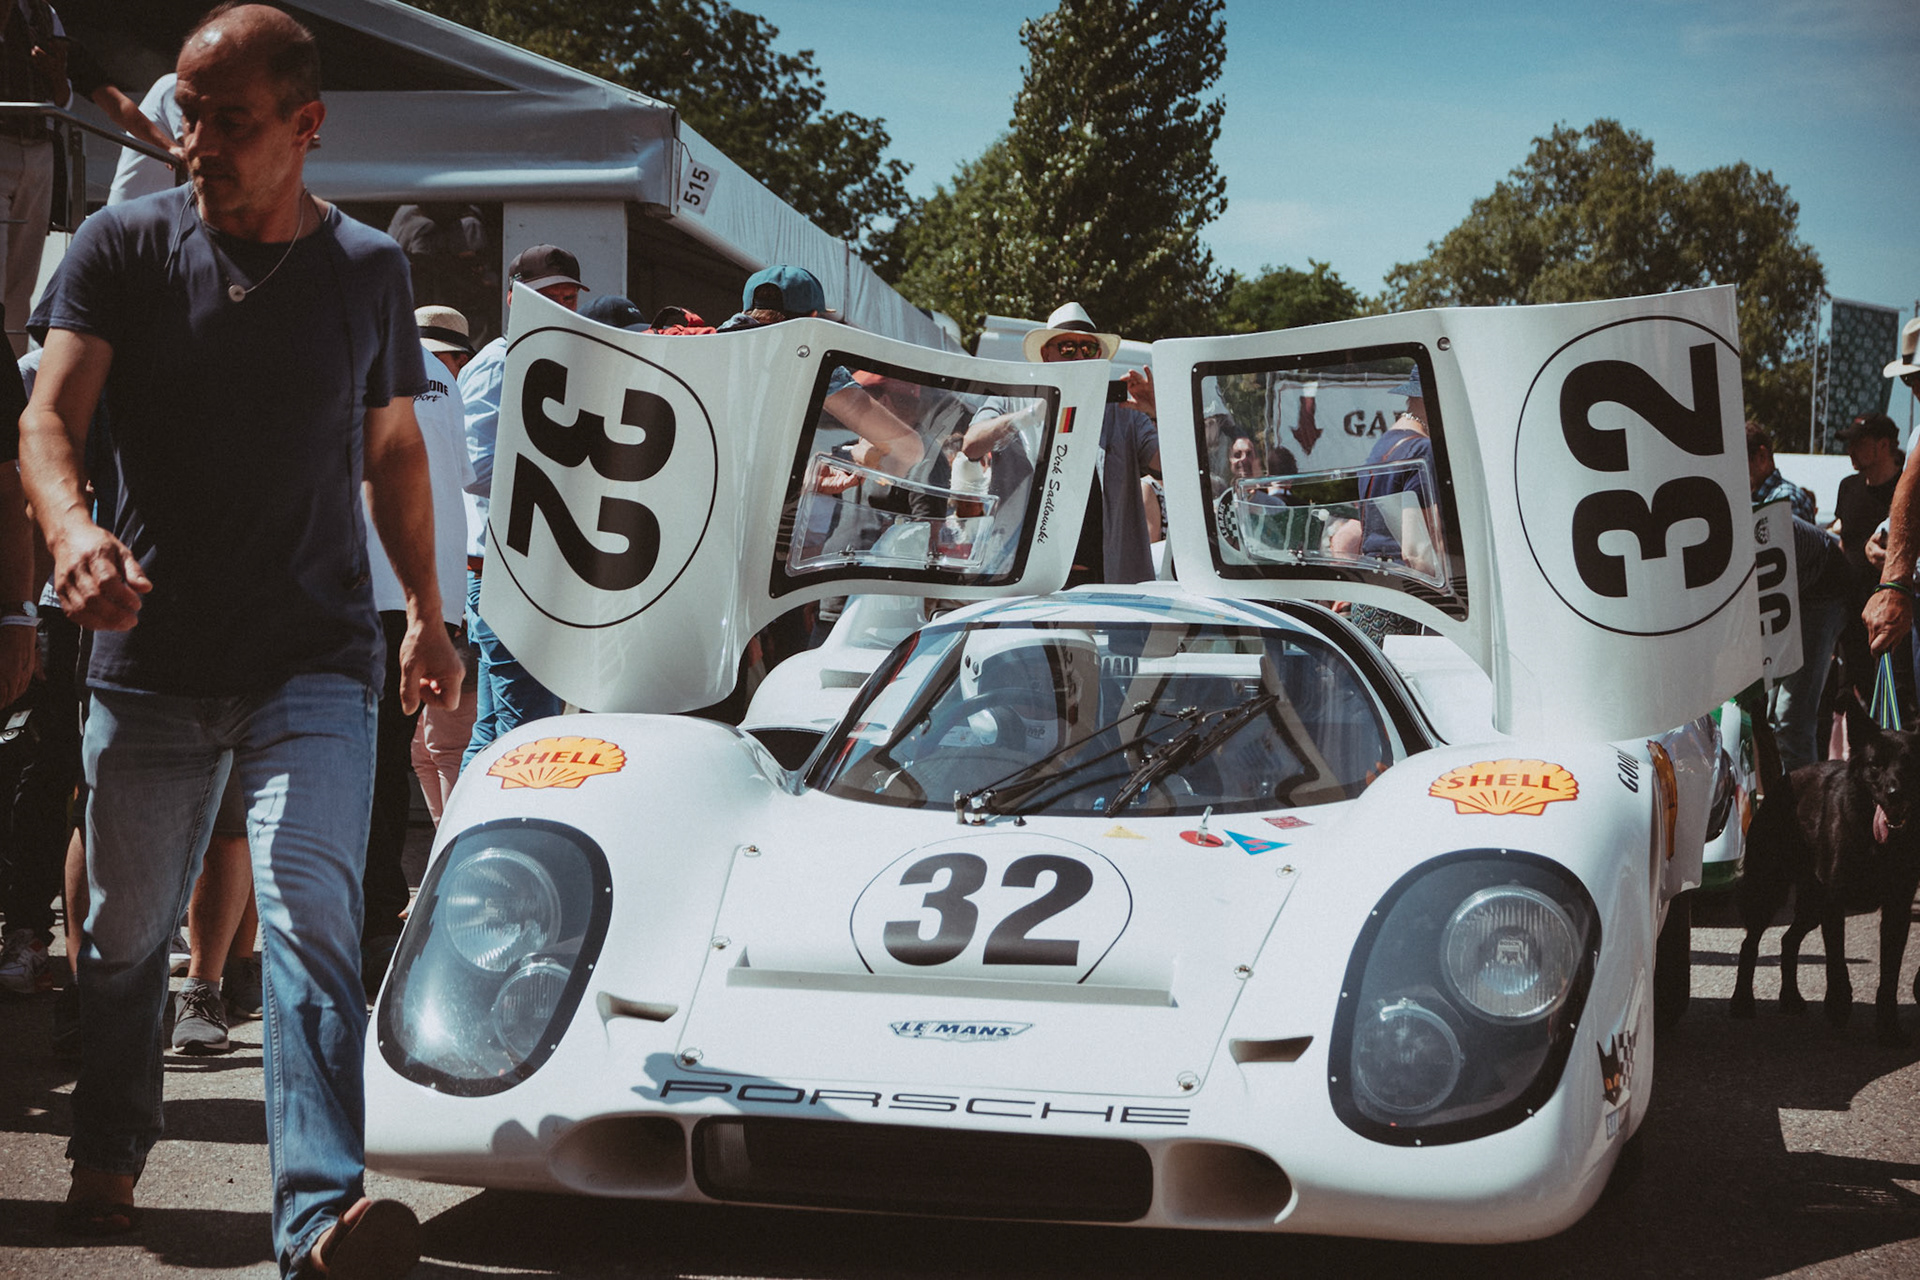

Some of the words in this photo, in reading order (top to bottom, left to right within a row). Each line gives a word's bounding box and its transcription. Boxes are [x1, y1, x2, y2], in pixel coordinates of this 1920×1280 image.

[683, 167, 709, 206] 515
[507, 358, 676, 591] 32
[1051, 444, 1068, 475] Dirk
[1560, 342, 1733, 598] 32
[504, 751, 605, 767] SHELL
[1446, 773, 1560, 792] SHELL
[883, 852, 1093, 967] 32
[900, 1022, 927, 1032] LE
[935, 1024, 1014, 1037] MANS
[660, 1079, 1190, 1126] PORSCHE
